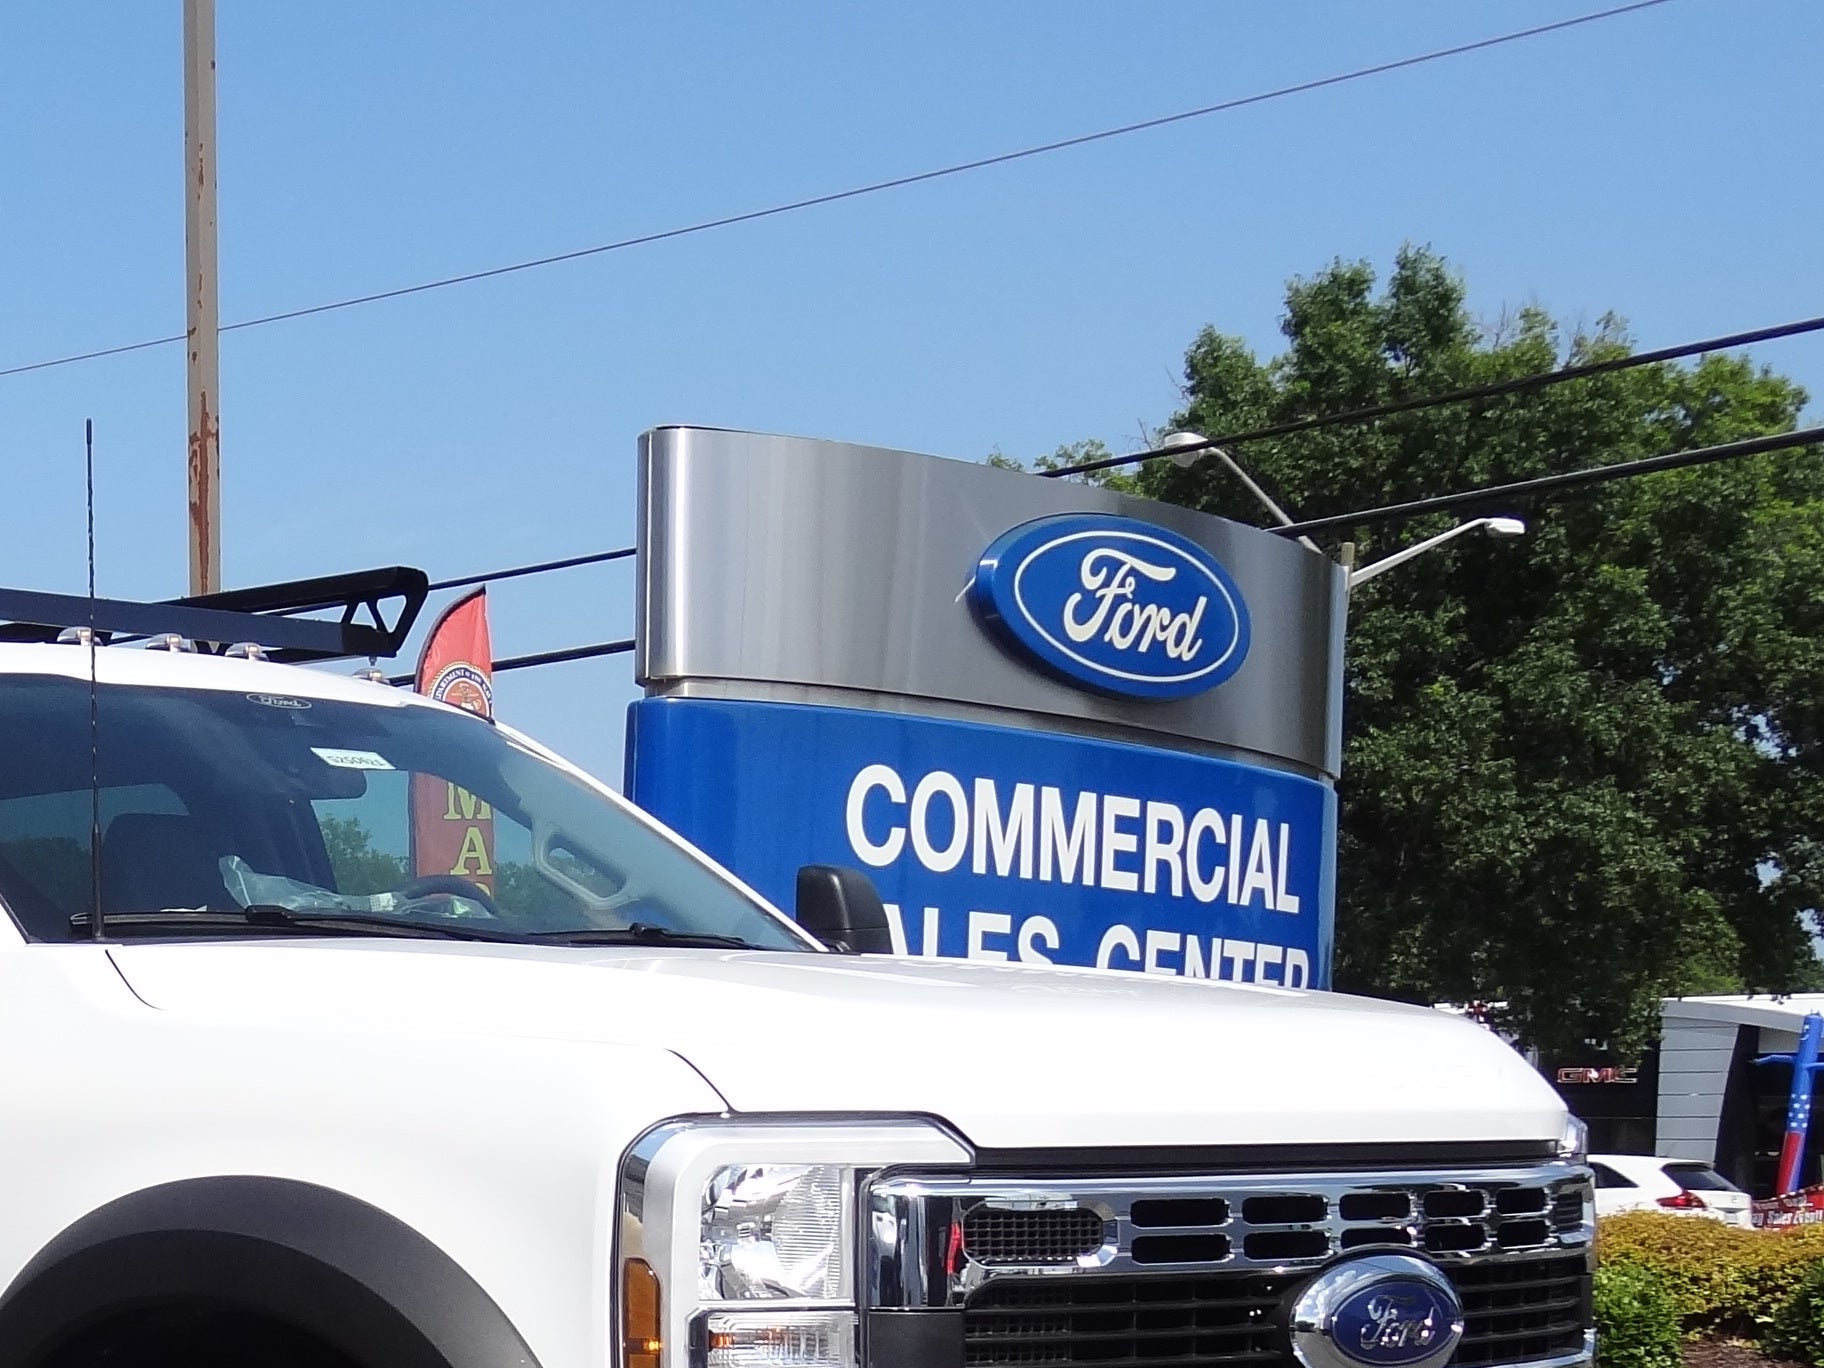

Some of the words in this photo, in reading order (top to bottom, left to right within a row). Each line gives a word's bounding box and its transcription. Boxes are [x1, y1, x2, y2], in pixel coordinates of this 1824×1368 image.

[1064, 548, 1208, 662] Ford
[259, 694, 302, 708] Ford
[846, 764, 1300, 914] COMMERCIAL
[1557, 1067, 1638, 1083] GMC
[1360, 1294, 1435, 1350] Ford
